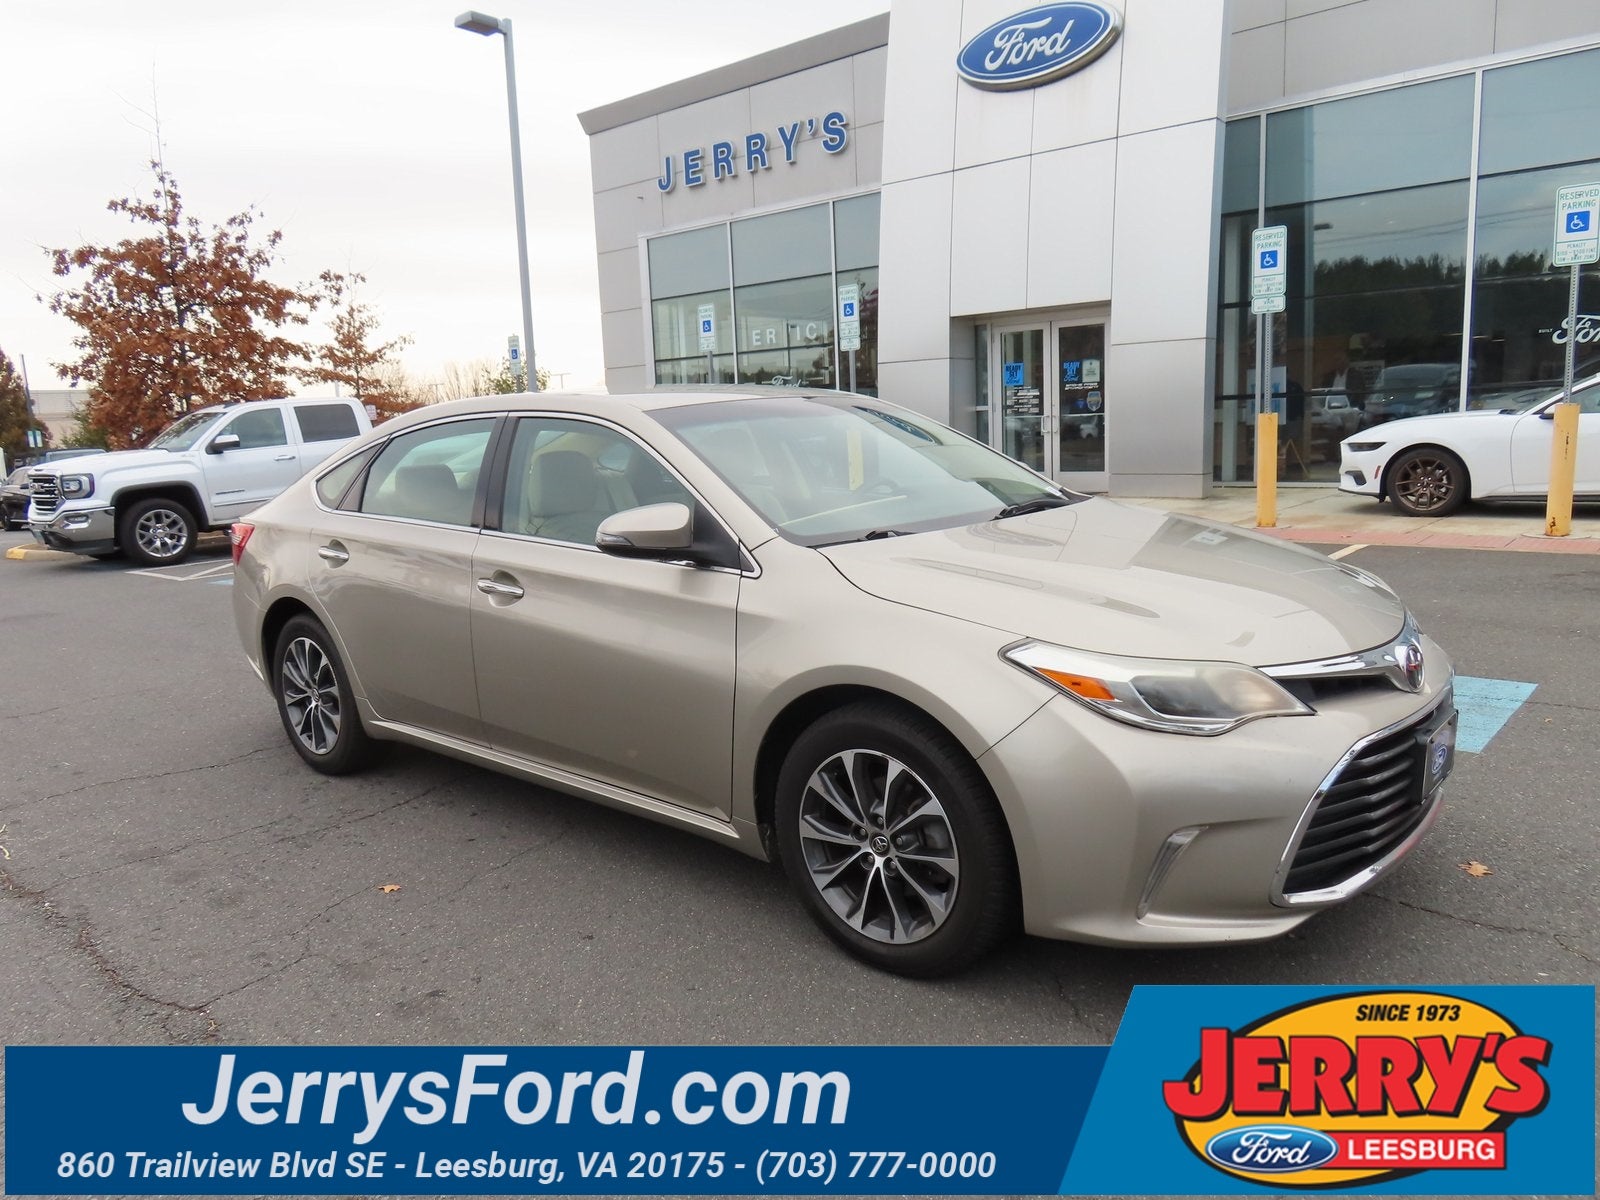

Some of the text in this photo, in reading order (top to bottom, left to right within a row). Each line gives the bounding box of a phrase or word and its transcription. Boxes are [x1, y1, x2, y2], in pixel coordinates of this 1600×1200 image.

[984, 16, 1075, 71] Ford
[657, 111, 847, 193] JERRY'S
[1559, 188, 1600, 200] RESERVED
[1561, 200, 1596, 211] PARKING
[1256, 240, 1282, 250] PARKING
